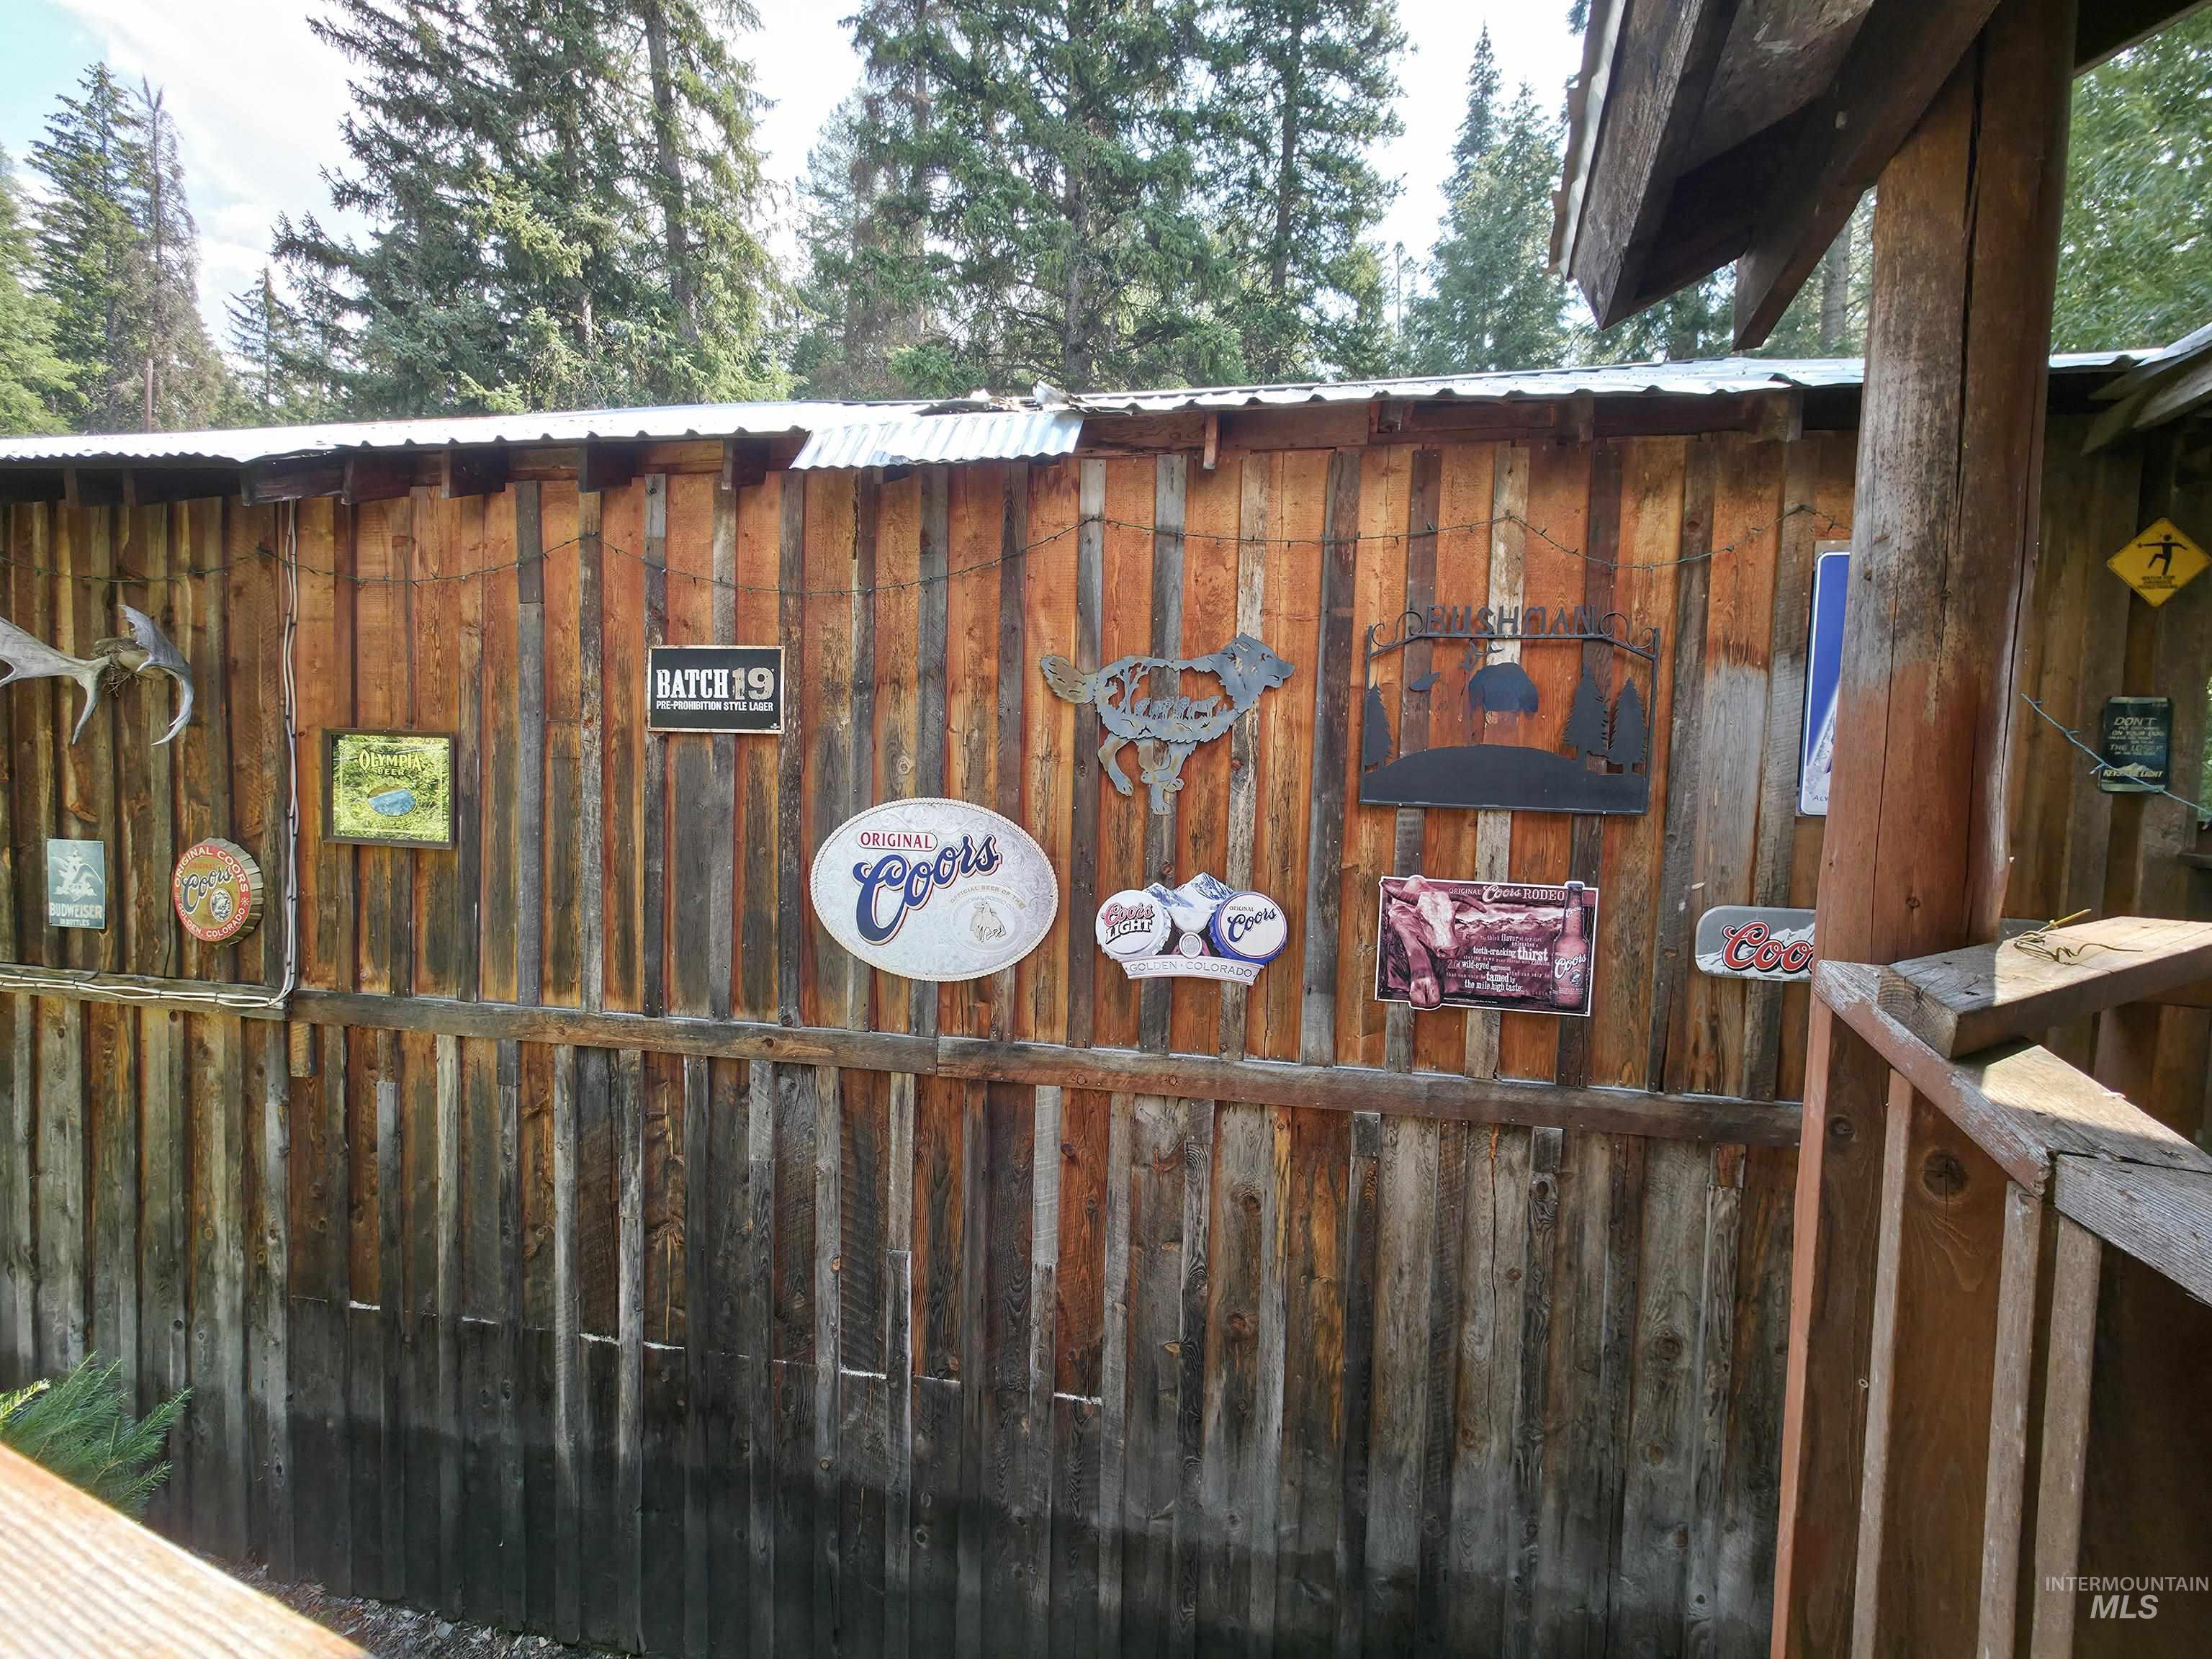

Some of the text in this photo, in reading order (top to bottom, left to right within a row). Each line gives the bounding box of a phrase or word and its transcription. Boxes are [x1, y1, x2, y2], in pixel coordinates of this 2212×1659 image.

[1426, 605, 1596, 635] BUSHMAN
[656, 667, 775, 700] BATCH 19
[656, 701, 774, 711] PRE-PROHIBITION STYLE LAGER
[359, 749, 423, 772] OLYMPIA
[860, 832, 932, 849] ORIGINAL
[174, 846, 248, 893] ORIGINAL COORS
[181, 866, 234, 914] Coors
[852, 834, 1002, 945] Coors
[950, 886, 979, 904] OFFICIAL
[1483, 884, 1523, 901] Coors
[1523, 888, 1565, 901] RODEO
[49, 902, 103, 919] BUDWEISER
[206, 907, 246, 937] COLORADO
[1101, 902, 1155, 926] Coors
[1105, 919, 1153, 944] LIGHT
[1227, 907, 1278, 943] Coors
[1473, 946, 1548, 961] tooth-cracking thirst
[1722, 920, 1815, 974] Coo
[1129, 961, 1253, 978] GOLDEN COLORADO
[1462, 960, 1490, 971] wild-eyed
[1486, 971, 1509, 983] tamed
[1554, 954, 1587, 979] Coors
[1465, 979, 1475, 989] the
[1476, 980, 1491, 990] mile
[1491, 981, 1505, 992] high
